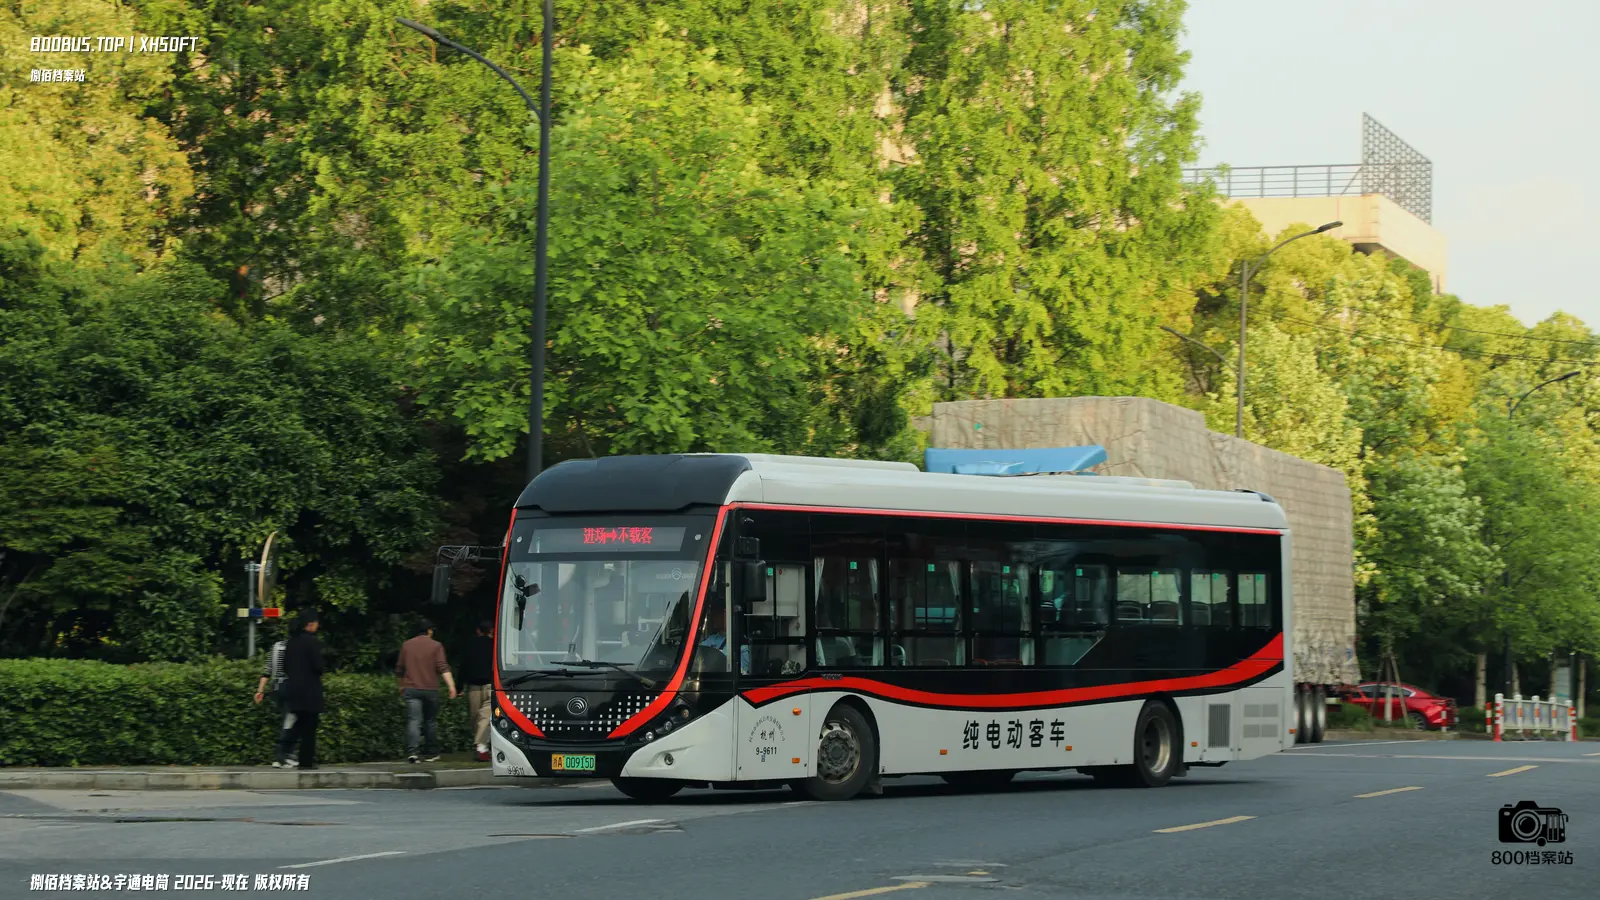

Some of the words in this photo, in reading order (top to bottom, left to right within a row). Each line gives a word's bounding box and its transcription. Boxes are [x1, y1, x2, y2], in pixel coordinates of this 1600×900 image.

[583, 527, 606, 544] 进场
[618, 527, 653, 544] 不载客
[963, 718, 1065, 749] 纯电动客车
[756, 747, 777, 755] 9-9611
